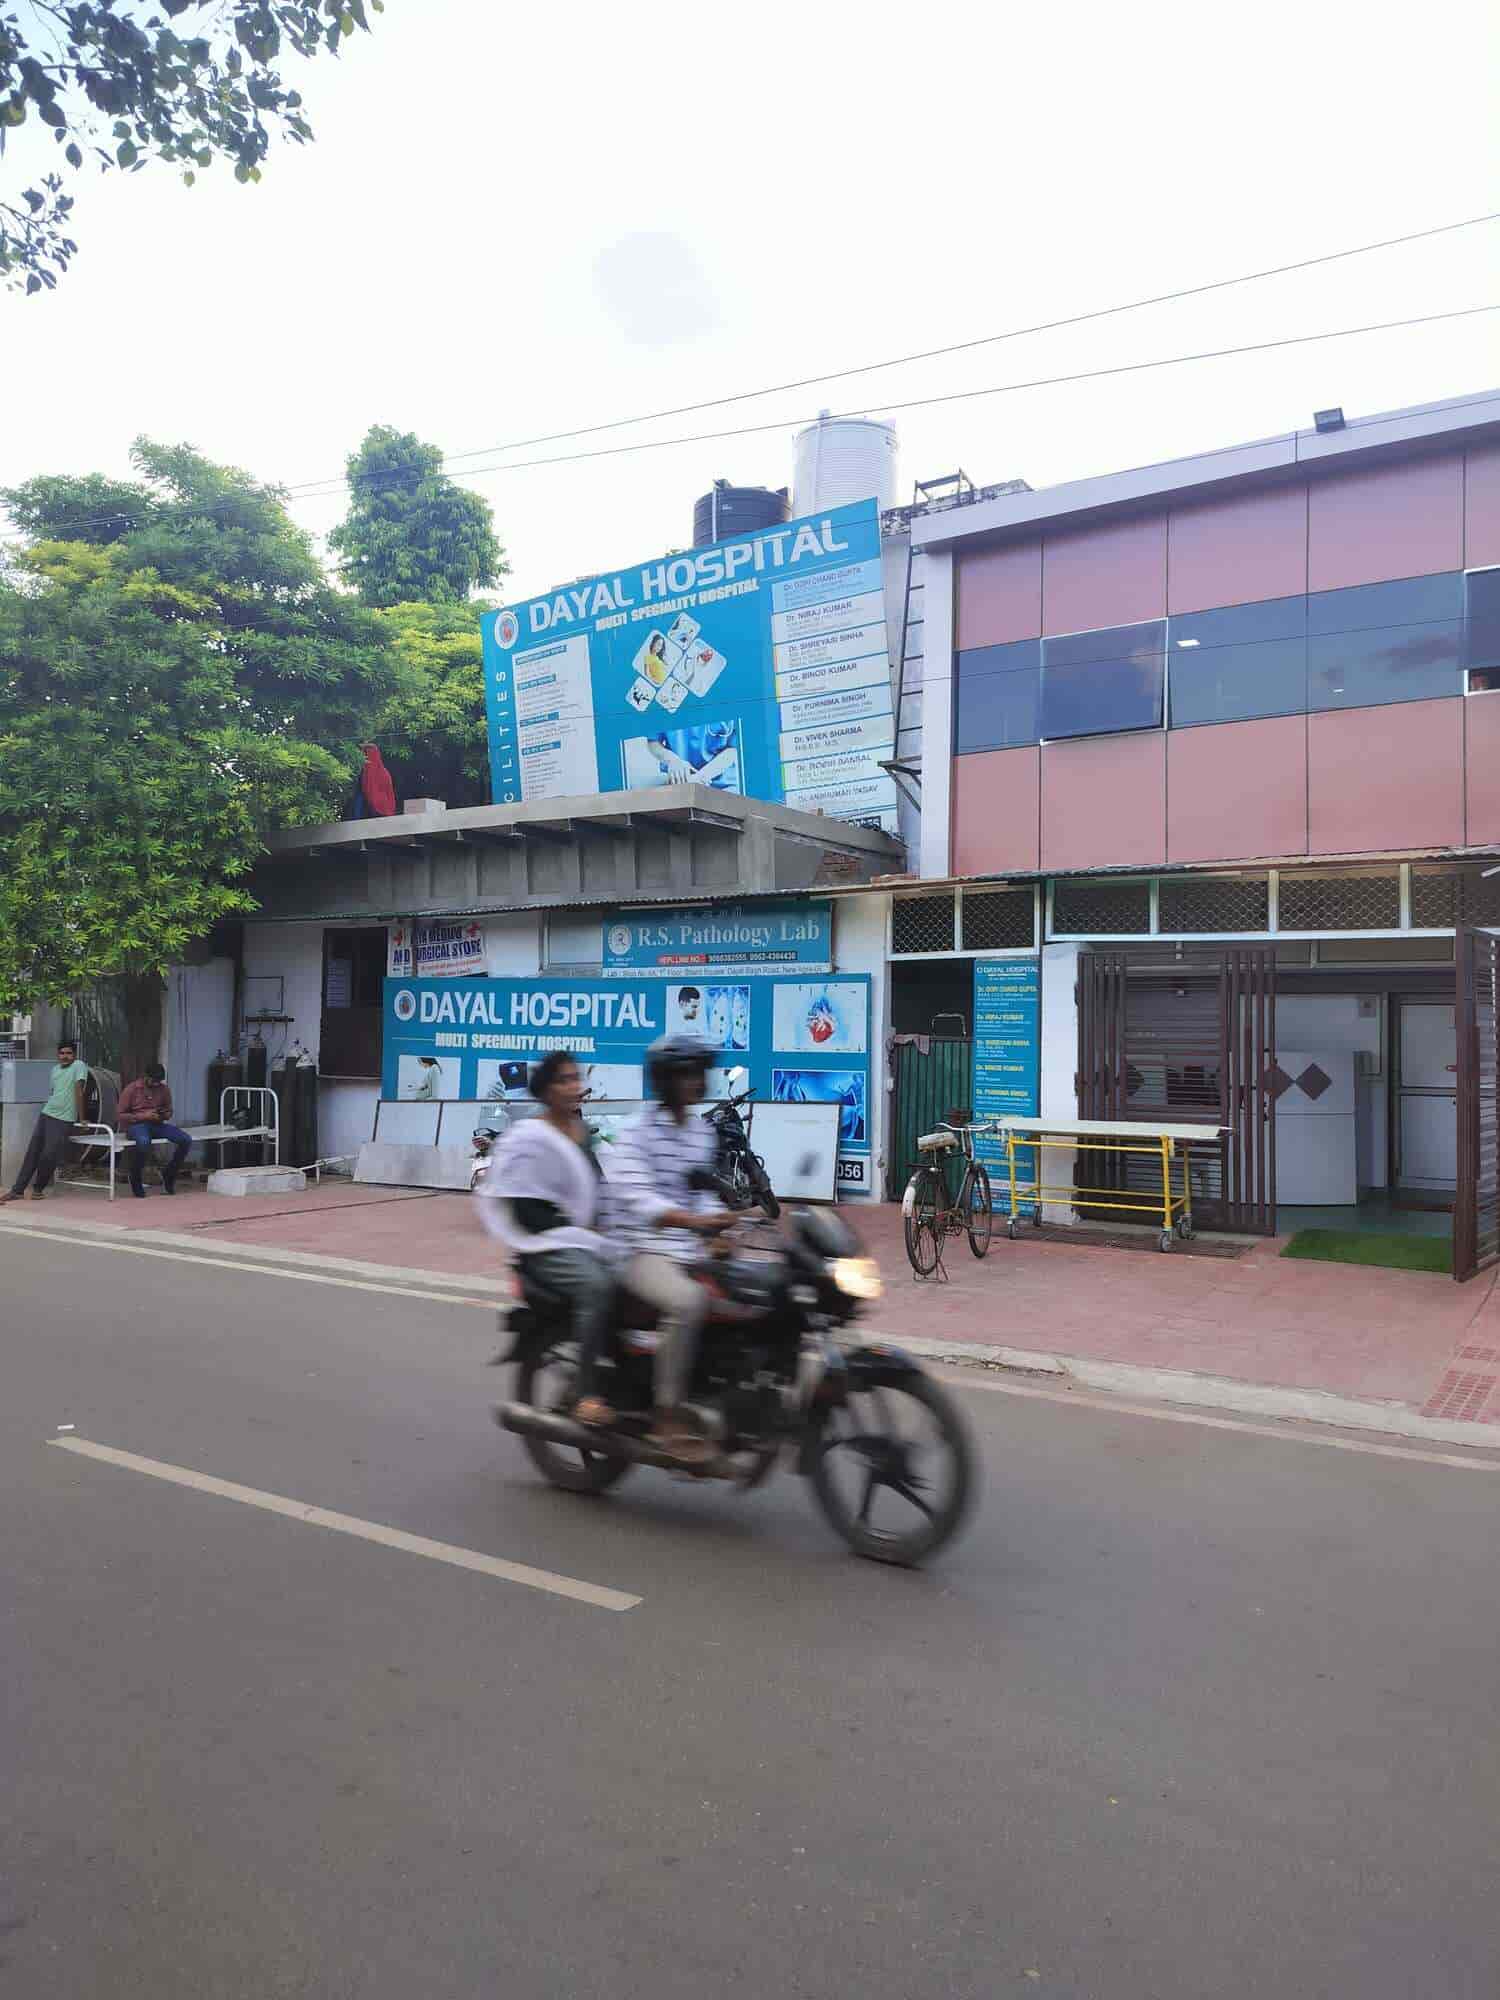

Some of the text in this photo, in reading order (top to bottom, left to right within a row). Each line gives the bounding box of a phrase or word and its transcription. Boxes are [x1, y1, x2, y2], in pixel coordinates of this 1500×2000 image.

[529, 577, 634, 633] DAYAL
[641, 519, 849, 601] HOSPITAL
[595, 612, 628, 632] MULTI
[631, 596, 698, 622] SPECIALITY
[699, 577, 761, 605] HOSPITAL
[823, 601, 853, 614] KUMAR
[828, 662, 857, 674] KUMAR
[841, 692, 867, 704] SINGH
[806, 732, 829, 743] VIVEK
[830, 725, 863, 737] SHARMA
[637, 919, 820, 949] R.S. Pathology Lab
[416, 943, 450, 963] URGICAL
[451, 938, 482, 959] STORE
[421, 991, 656, 1029] DAYAL HOSPITAL
[435, 1032, 595, 1053] MULTI SPECIALITY HOSPITAL
